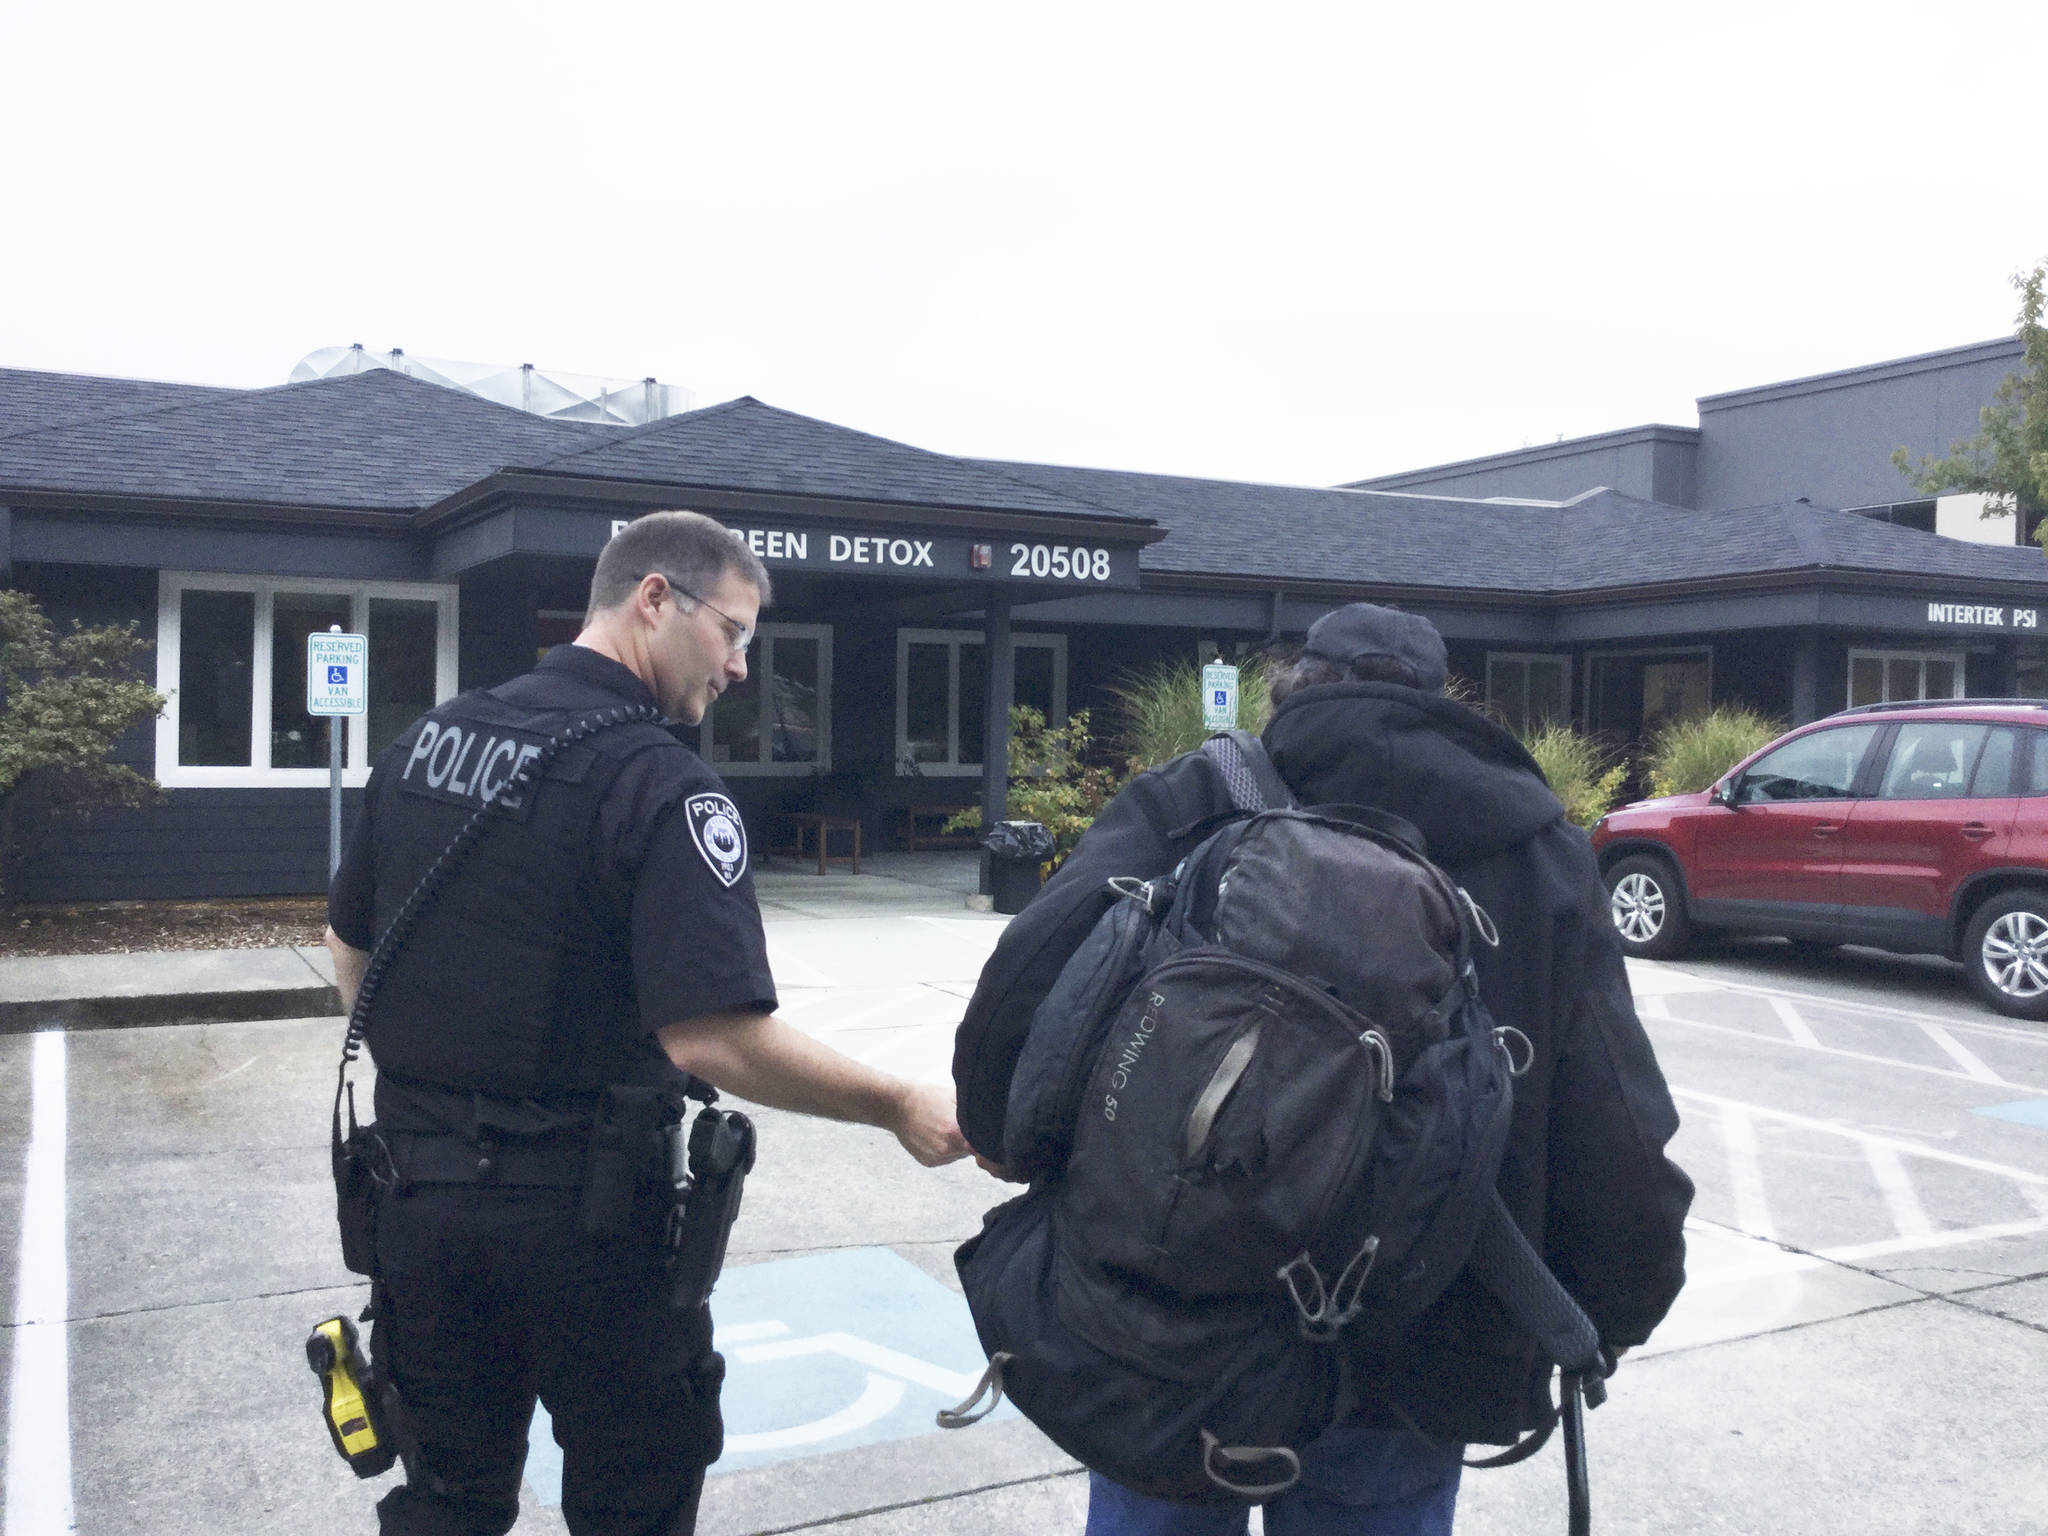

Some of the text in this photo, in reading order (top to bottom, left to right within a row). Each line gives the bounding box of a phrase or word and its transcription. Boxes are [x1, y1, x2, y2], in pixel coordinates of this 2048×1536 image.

[830, 535, 934, 567] DETOX
[1010, 543, 1111, 581] 20508
[1928, 603, 2037, 628] INTERTEK PSI
[313, 641, 362, 652] RESERVED
[316, 653, 359, 664] PARKING
[313, 697, 361, 708] ACCESSIBLE
[328, 687, 348, 696] VAN
[691, 800, 740, 826] POLICE
[1105, 991, 1165, 1121] REDWING 50
